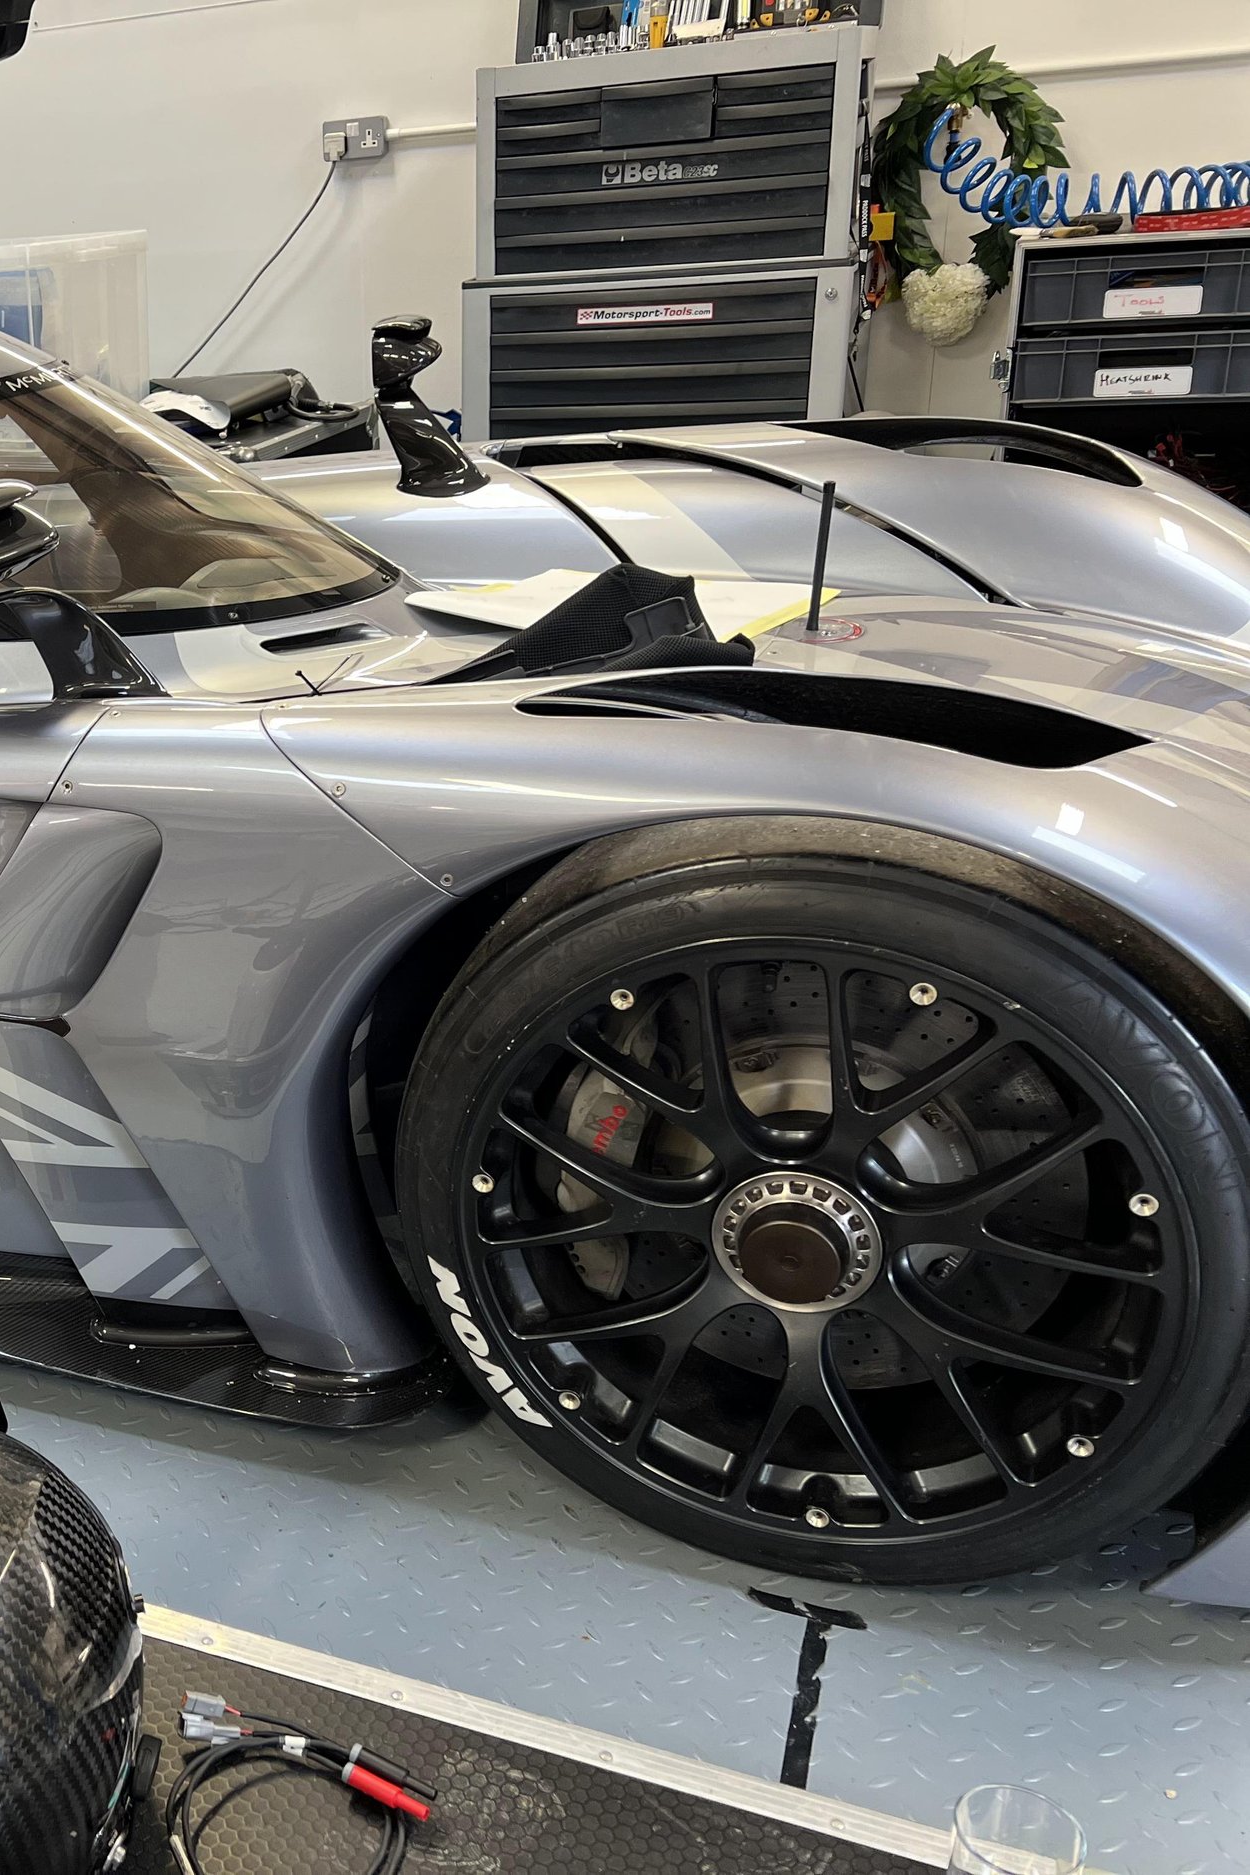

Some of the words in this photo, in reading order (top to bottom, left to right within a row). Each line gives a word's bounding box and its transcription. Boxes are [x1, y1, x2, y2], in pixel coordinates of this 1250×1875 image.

[623, 160, 683, 184] Beta
[593, 306, 711, 321] Motorsport-Tools.com
[426, 1254, 553, 1428] AVON
